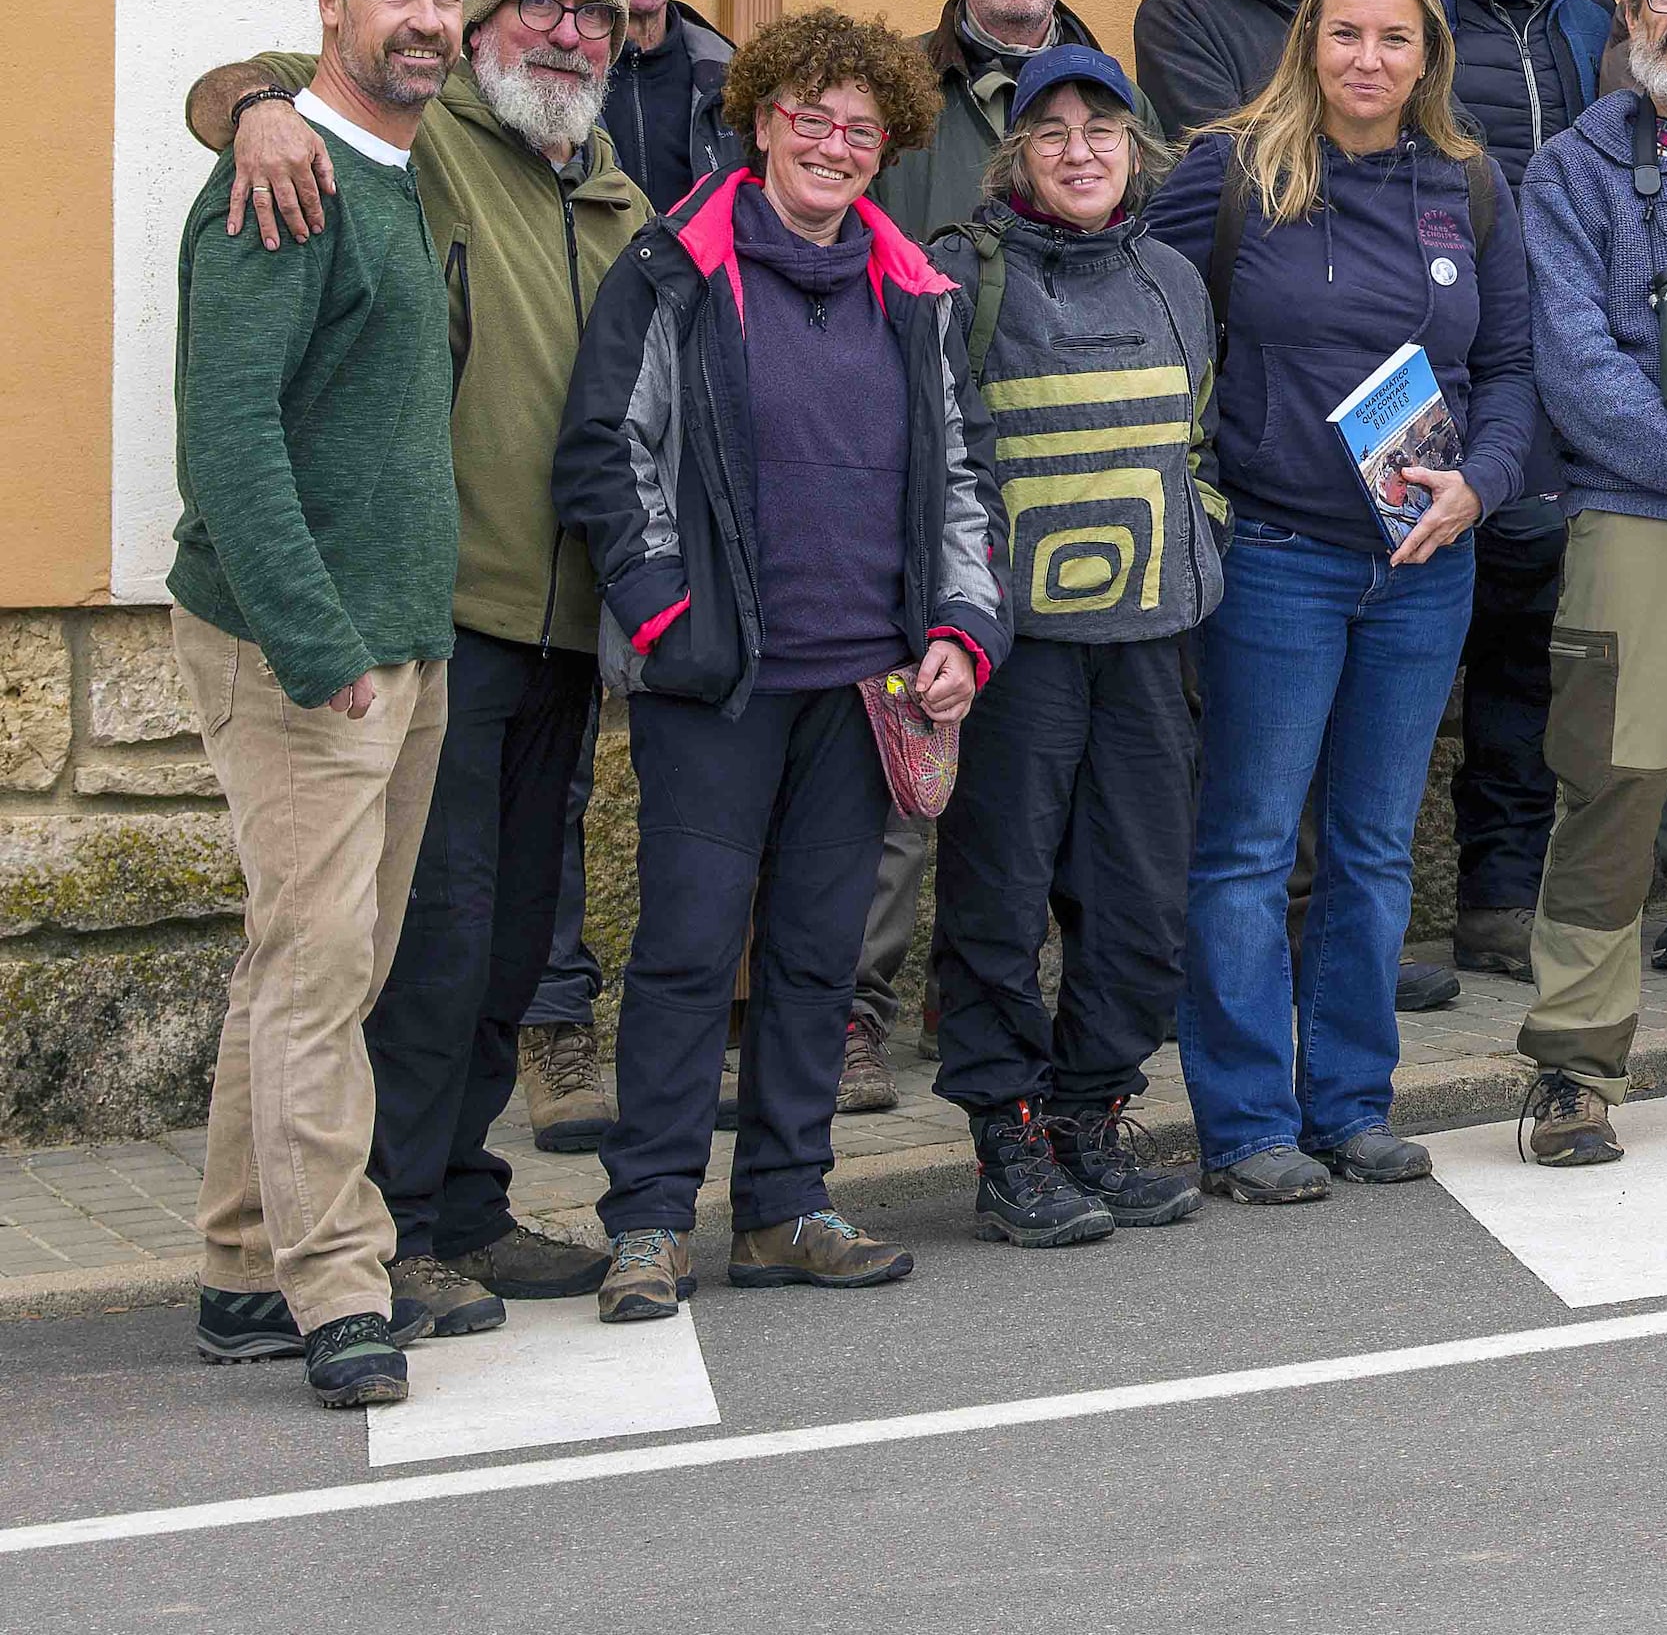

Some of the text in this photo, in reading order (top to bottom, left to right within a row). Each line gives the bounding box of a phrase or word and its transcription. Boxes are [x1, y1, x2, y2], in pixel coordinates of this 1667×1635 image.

[1355, 367, 1409, 419] EL MATEMÁTICO
[1362, 408, 1377, 424] QUE
[1377, 379, 1410, 410] CONTABA
[1373, 392, 1410, 430] BUITRES
